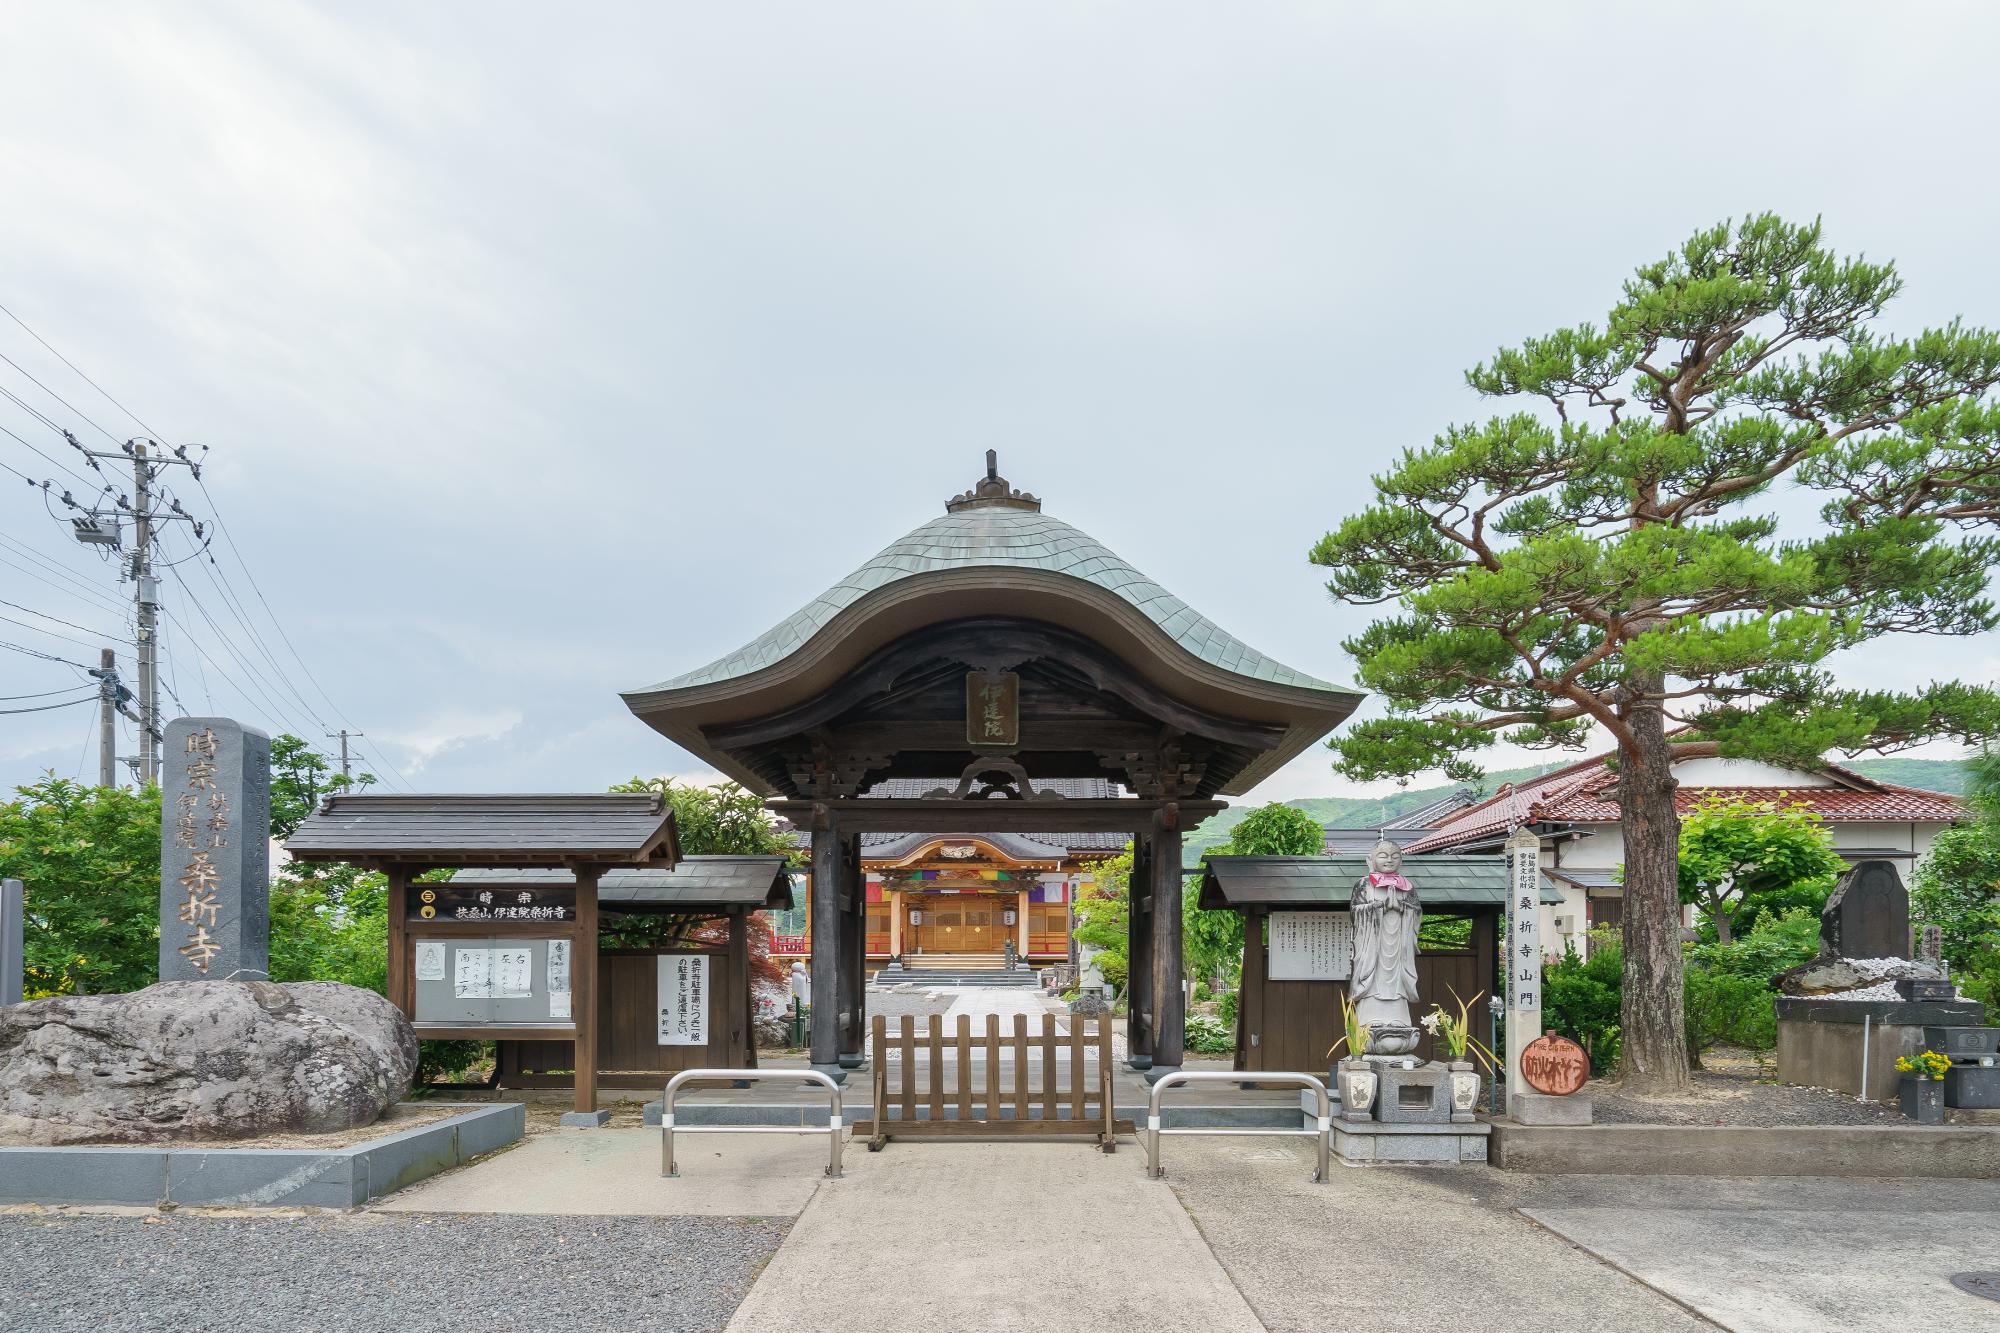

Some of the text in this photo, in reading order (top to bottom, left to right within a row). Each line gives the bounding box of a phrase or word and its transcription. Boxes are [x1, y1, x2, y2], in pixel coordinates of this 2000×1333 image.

[185, 728, 219, 790] 時宗
[1519, 852, 1528, 889] 重要文化財
[1527, 852, 1536, 890] 福島県指定
[178, 851, 223, 974] 桑折寺
[1519, 896, 1533, 1005] 桑折寺山門
